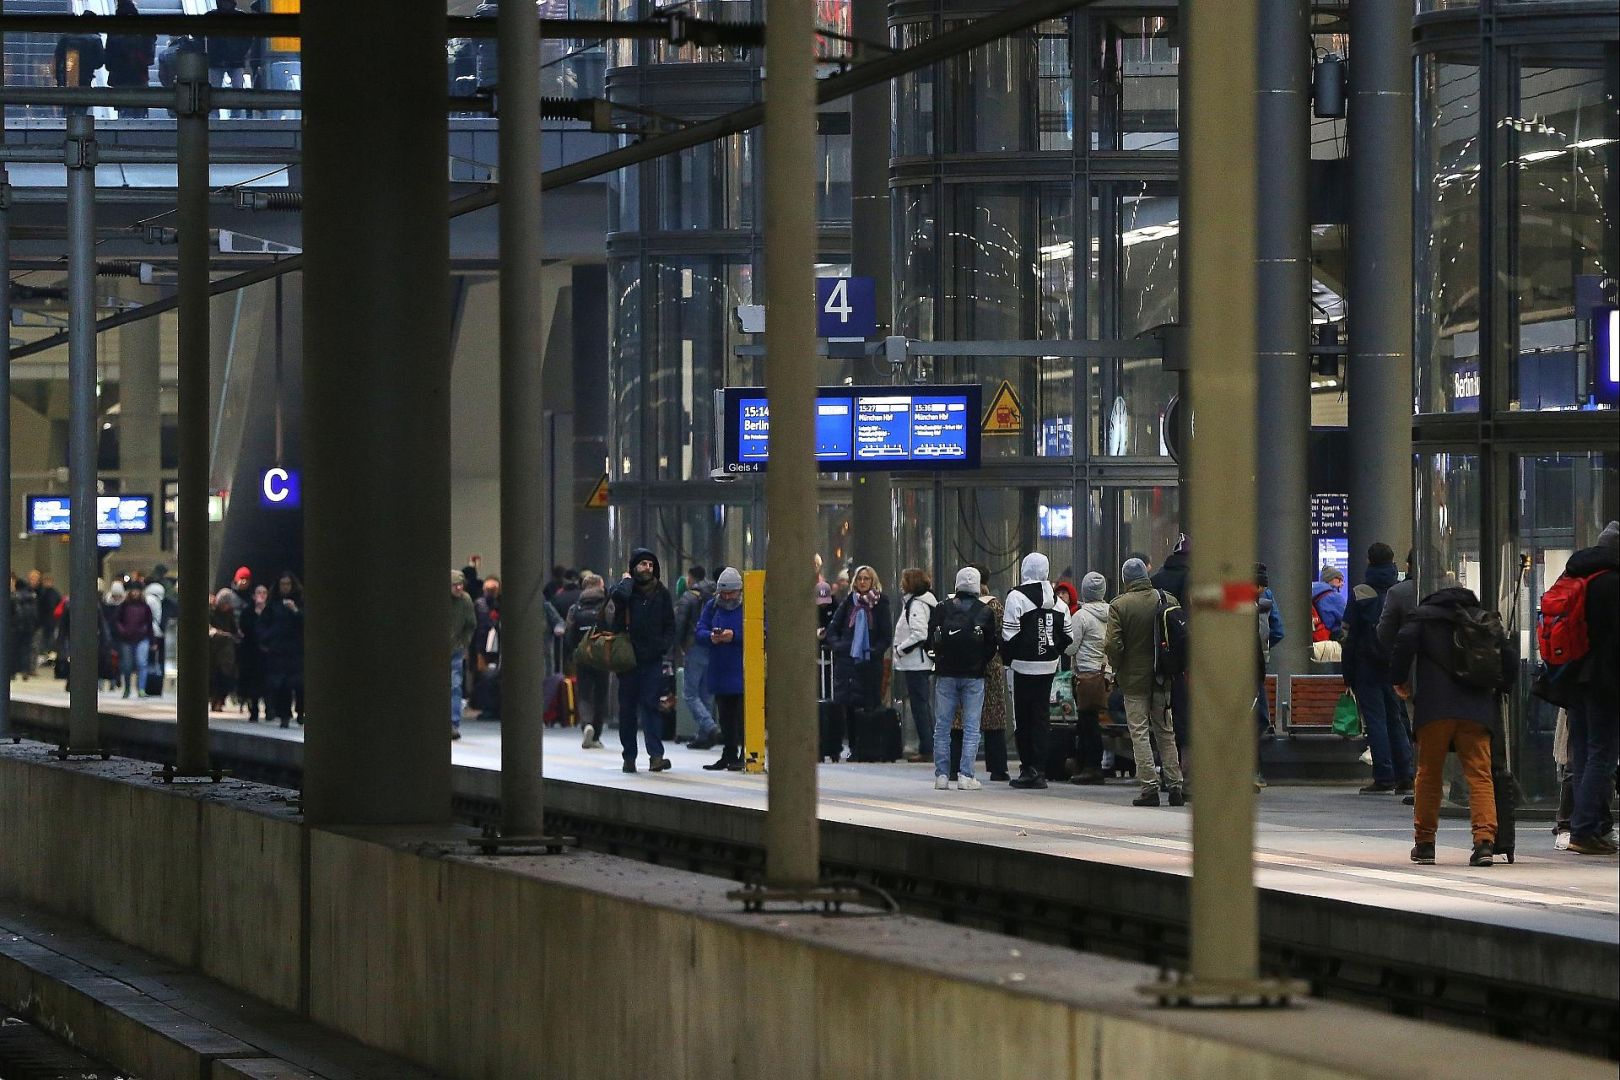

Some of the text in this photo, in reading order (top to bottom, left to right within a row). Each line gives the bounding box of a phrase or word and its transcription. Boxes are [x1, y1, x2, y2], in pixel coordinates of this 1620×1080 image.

[825, 280, 852, 322] 4
[744, 419, 769, 431] Berlin
[728, 462, 759, 472] Gleis 4
[263, 467, 289, 502] C
